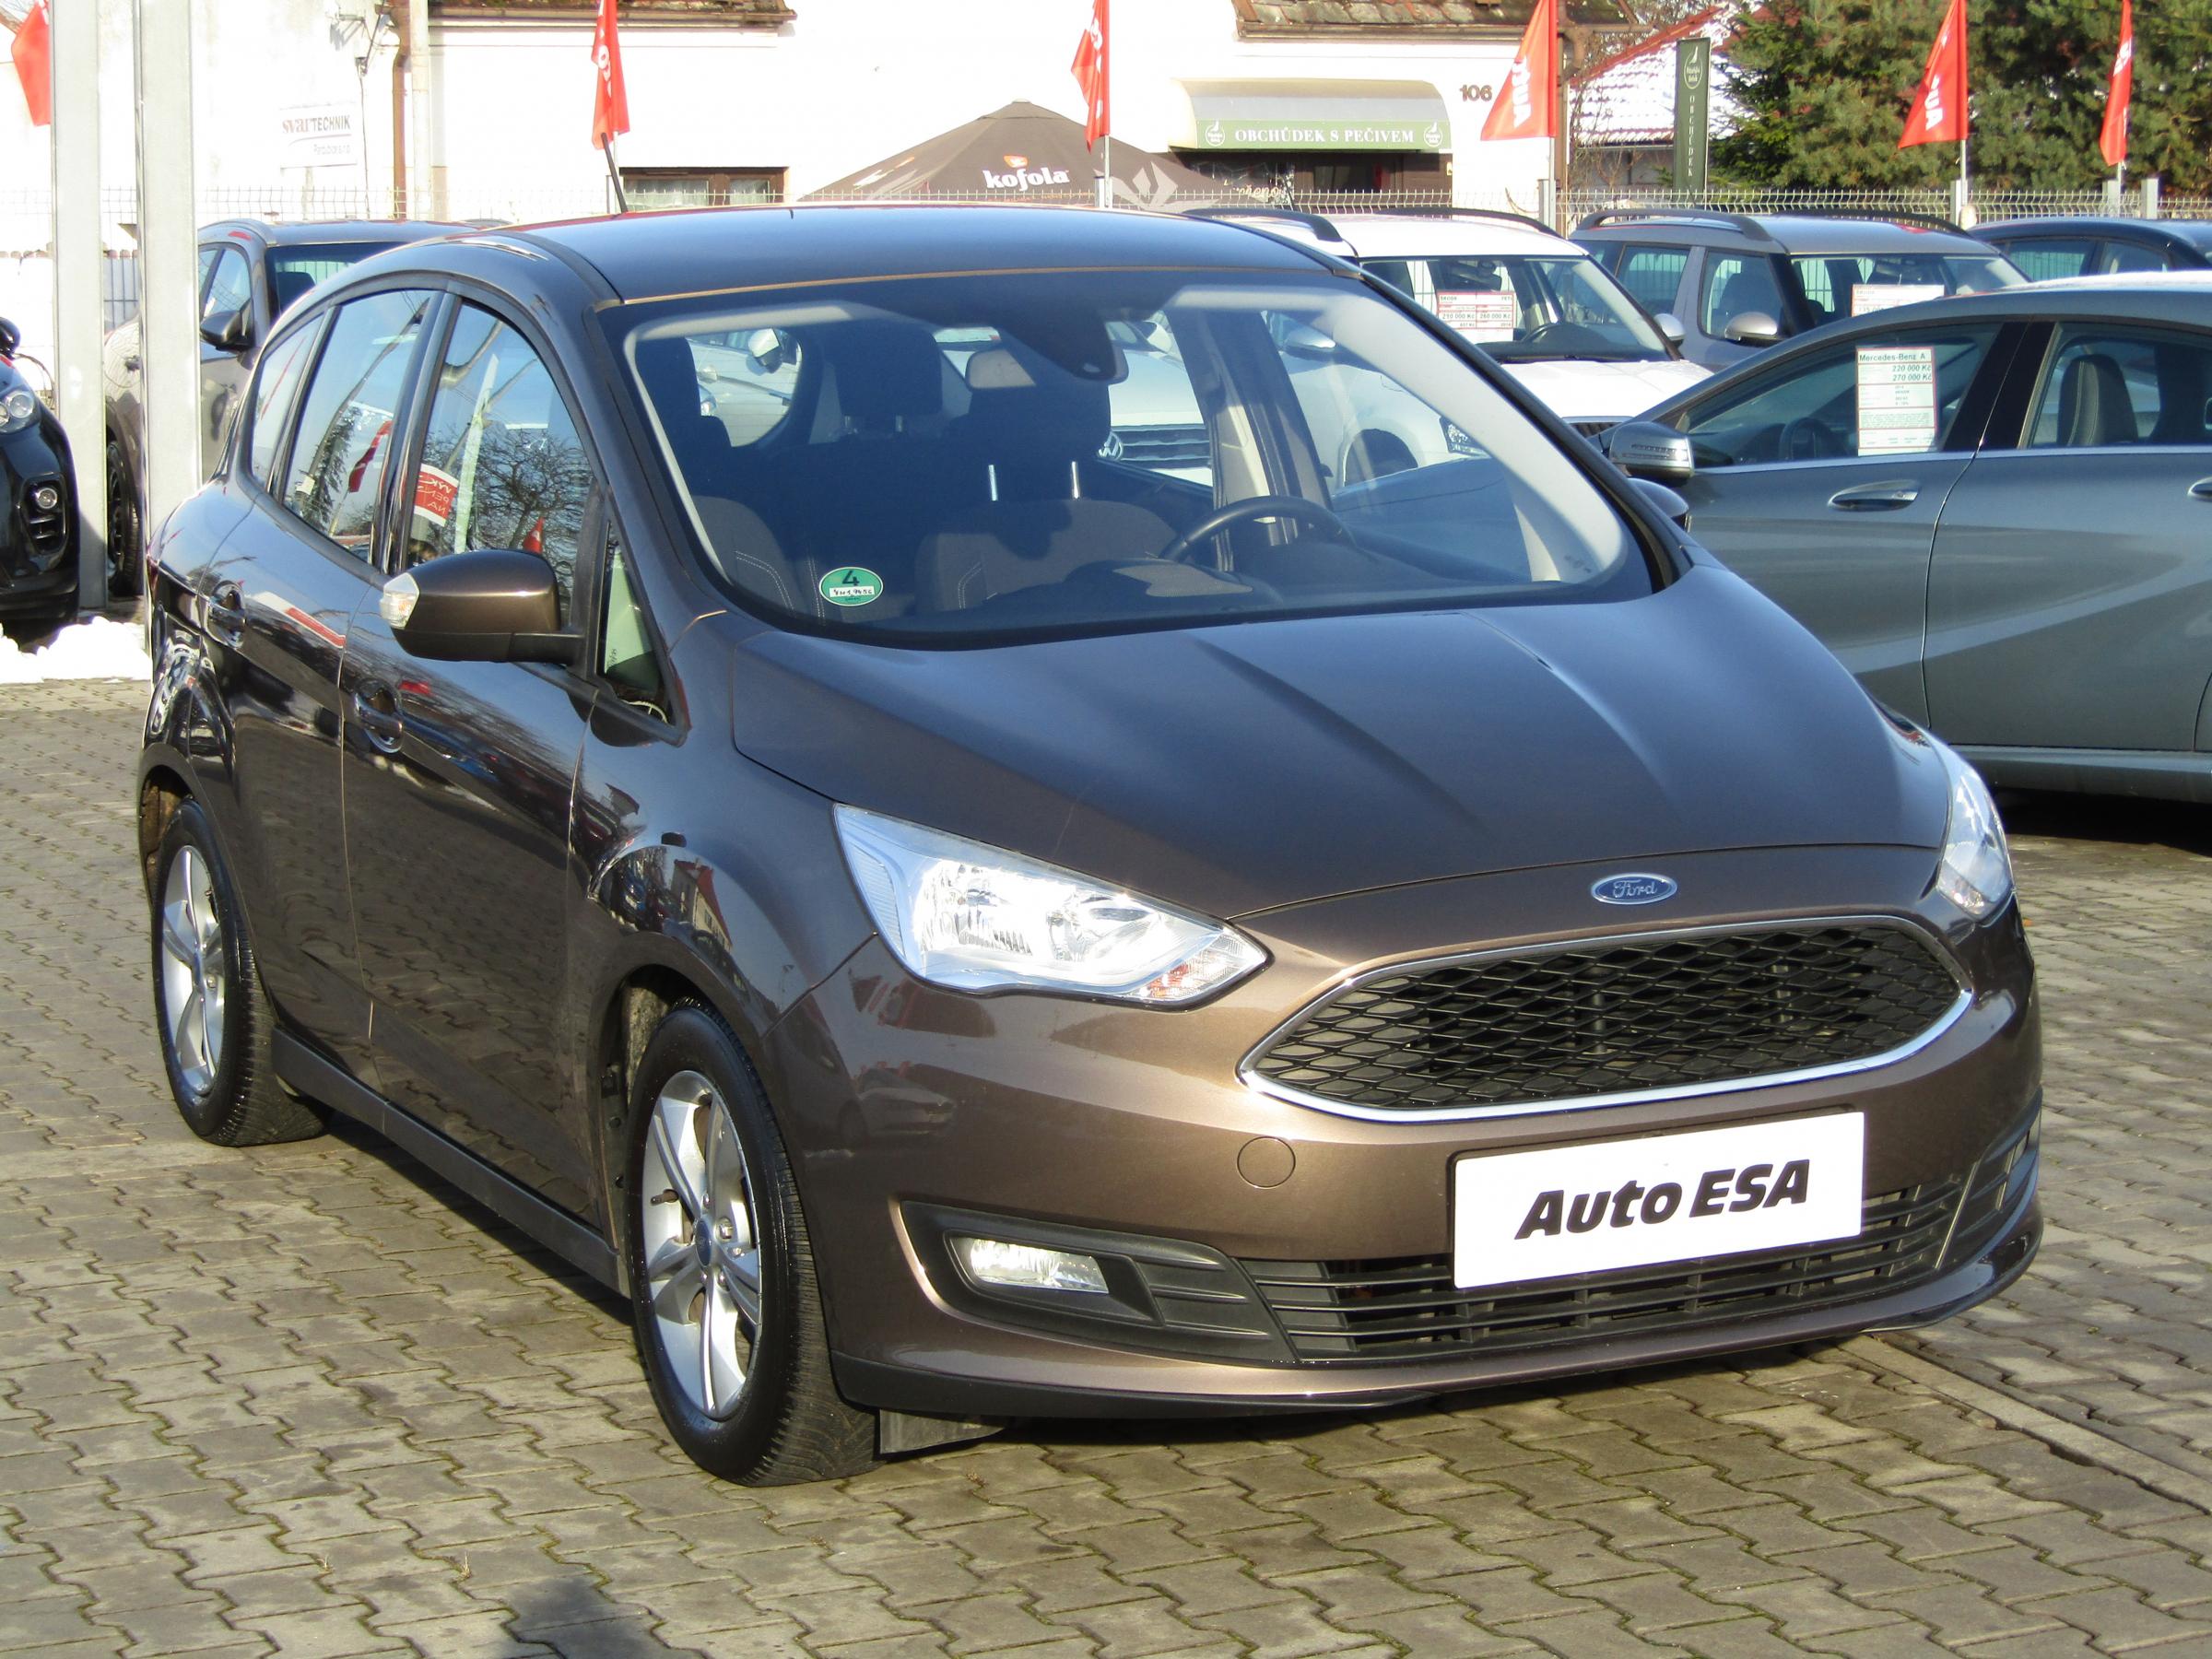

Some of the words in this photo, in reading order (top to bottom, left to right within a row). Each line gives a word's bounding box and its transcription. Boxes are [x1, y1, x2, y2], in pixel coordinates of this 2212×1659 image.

[1459, 84, 1492, 101] 106
[1235, 126, 1325, 142] OBCHŮDEK
[1330, 130, 1340, 142] S
[1345, 126, 1414, 143] PEČIVEM
[982, 168, 1069, 191] kofola
[1859, 353, 1916, 362] Mercedes-Benz
[841, 570, 860, 586] 4
[1613, 879, 1658, 898] Ford
[1514, 1180, 1682, 1240] Auto
[1688, 1159, 1810, 1218] ESA
